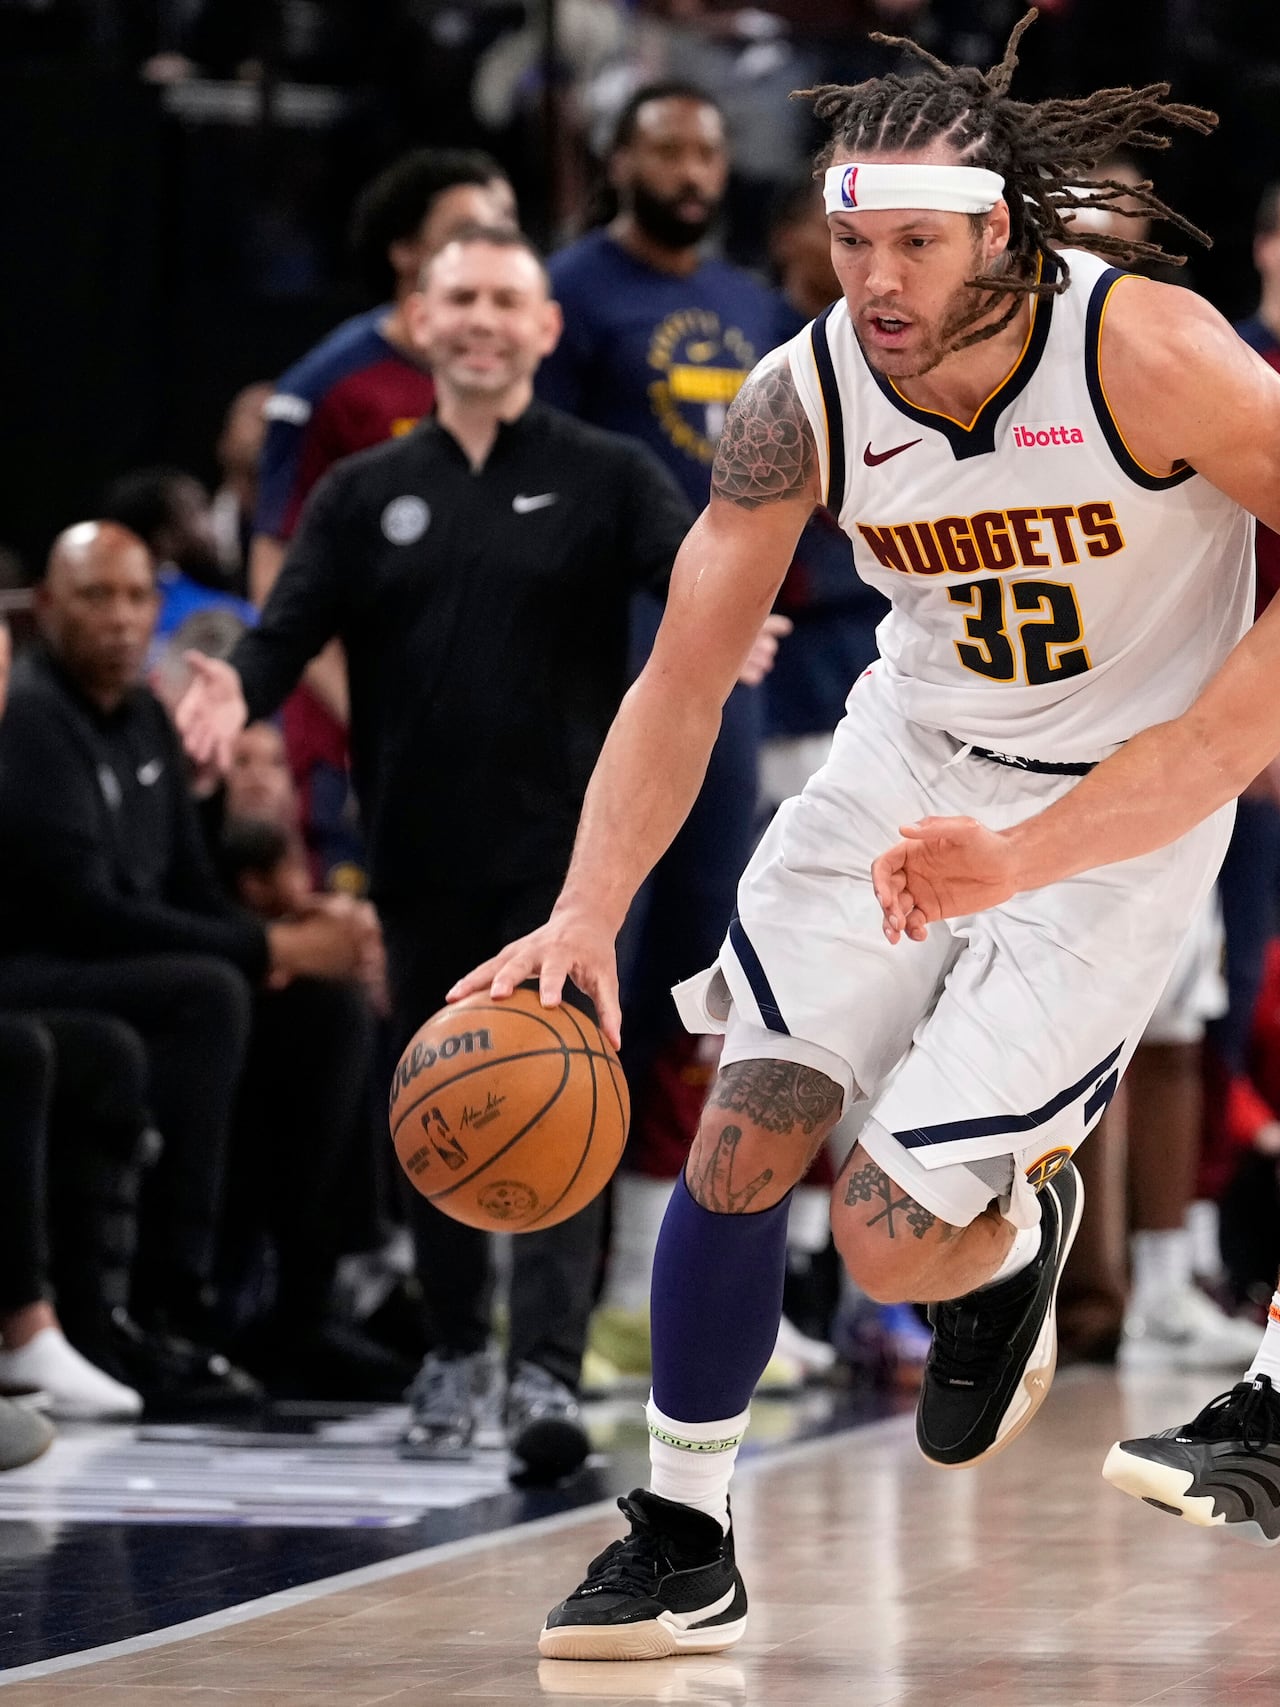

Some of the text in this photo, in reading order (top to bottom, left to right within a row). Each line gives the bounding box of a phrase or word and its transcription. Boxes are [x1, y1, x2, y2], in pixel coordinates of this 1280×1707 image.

[1013, 425, 1084, 448] ibotta
[855, 501, 1126, 575] NUGGETS
[947, 577, 1093, 687] 32
